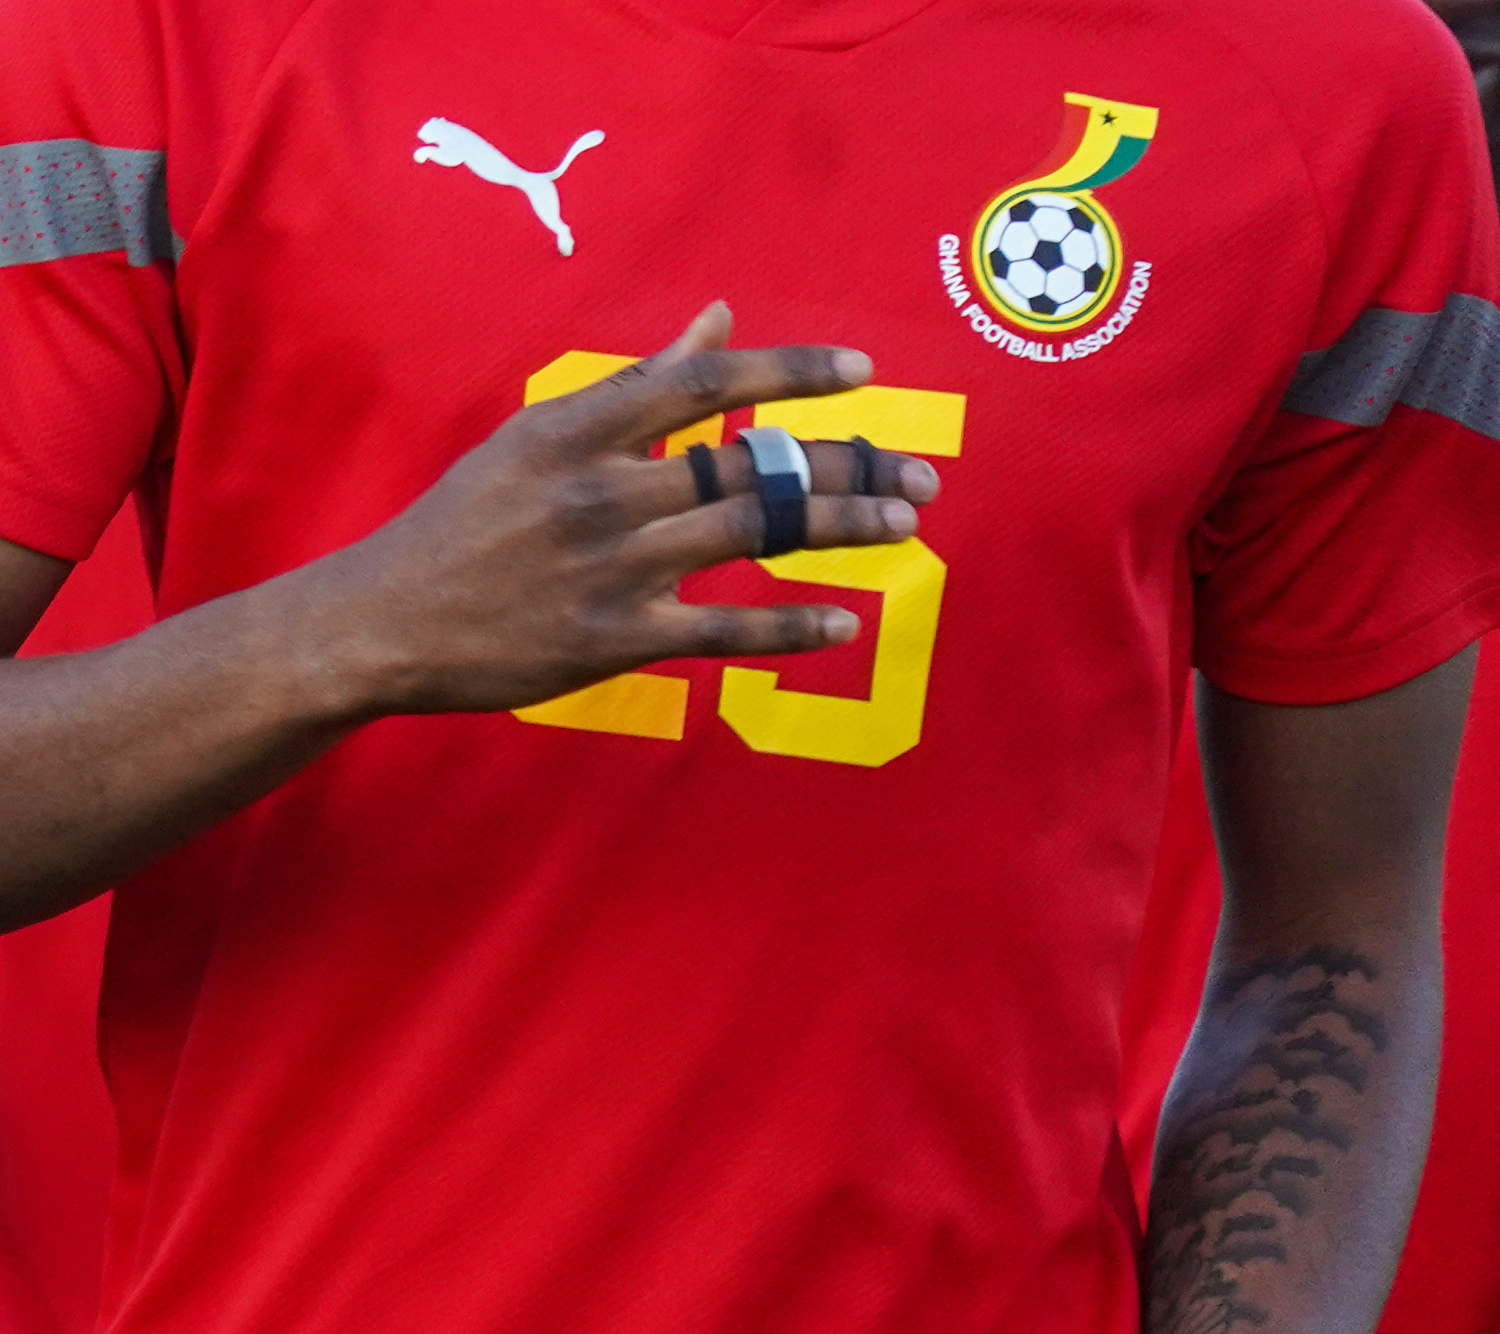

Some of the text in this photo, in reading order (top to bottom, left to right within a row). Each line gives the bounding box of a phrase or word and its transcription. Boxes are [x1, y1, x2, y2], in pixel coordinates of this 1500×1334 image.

[938, 233, 1153, 362] GHANA FOOTBALL ASSOCIATION
[509, 349, 967, 768] 5
